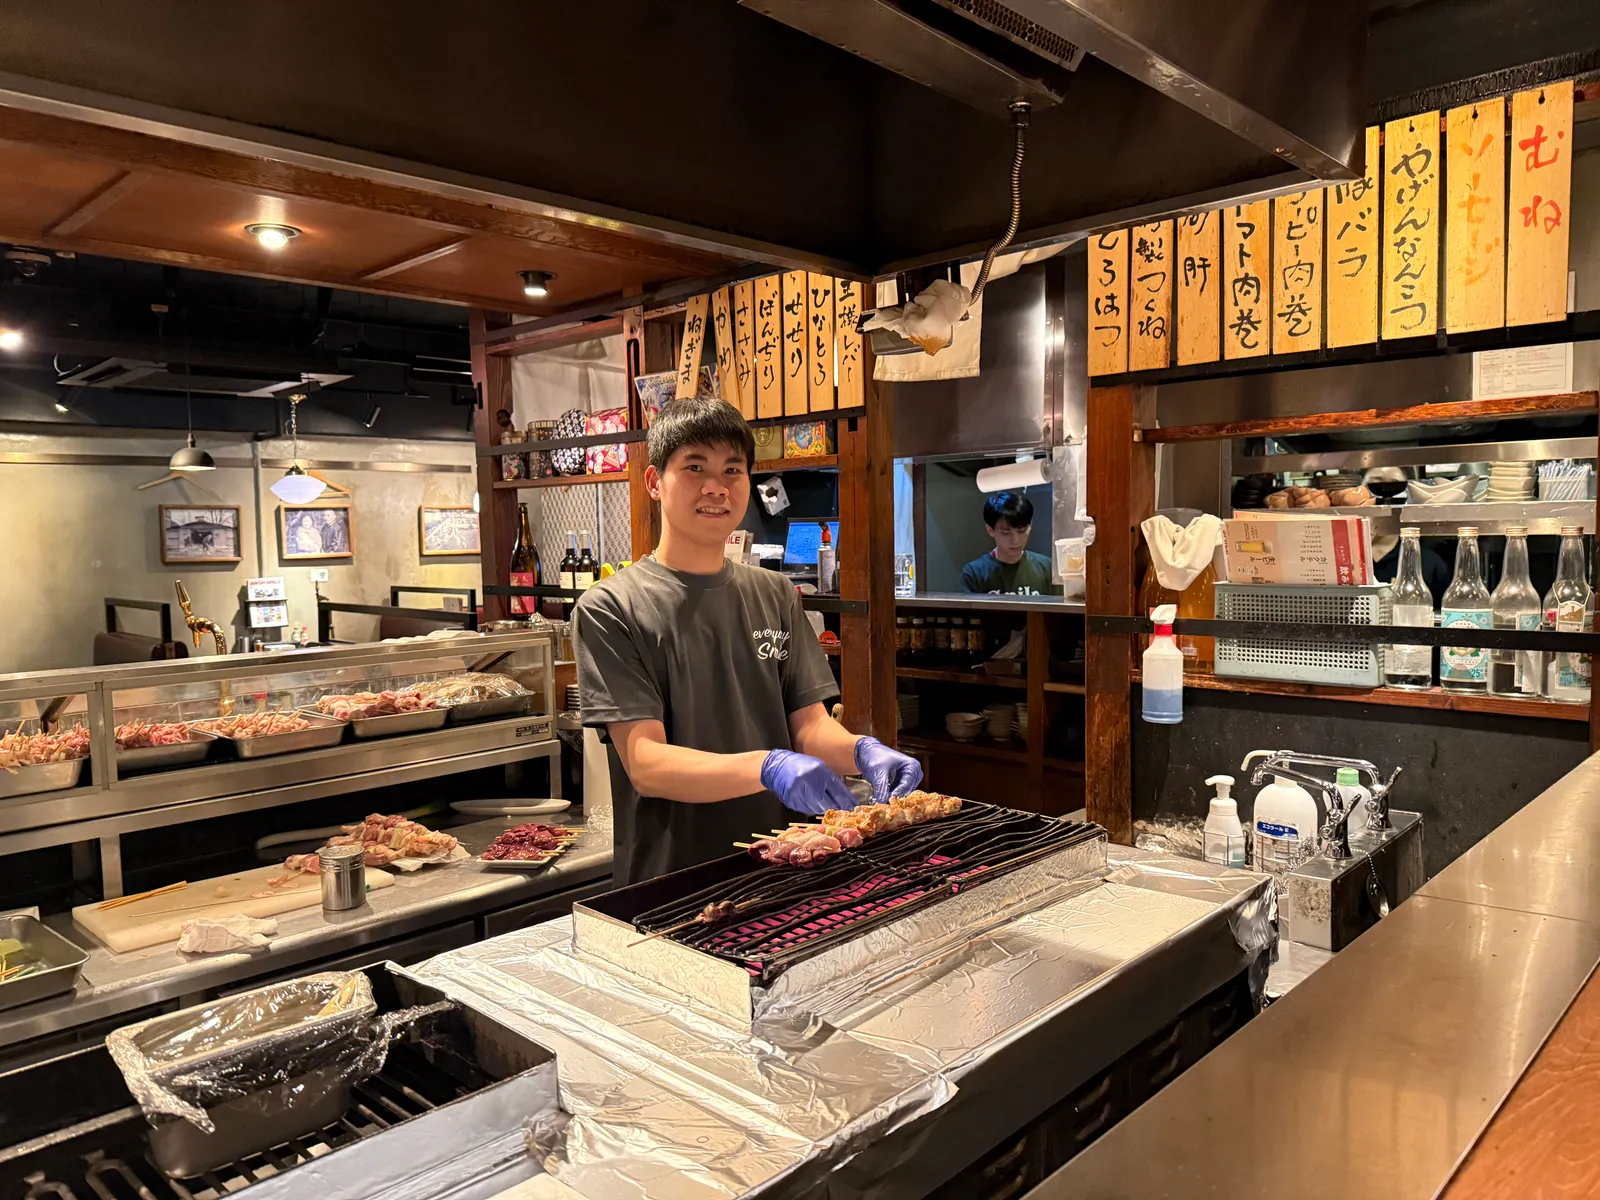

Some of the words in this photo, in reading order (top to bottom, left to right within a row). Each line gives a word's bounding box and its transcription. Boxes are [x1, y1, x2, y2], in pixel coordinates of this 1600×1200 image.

[1457, 133, 1500, 286] ソーセージ
[1519, 125, 1564, 235] むね
[1390, 143, 1434, 330] やげんなんこつ
[681, 314, 702, 385] ねぎま
[716, 306, 731, 373] かわ
[737, 301, 751, 388] ささみ
[785, 292, 803, 378] せせり
[1339, 566, 1350, 585] 飲み
